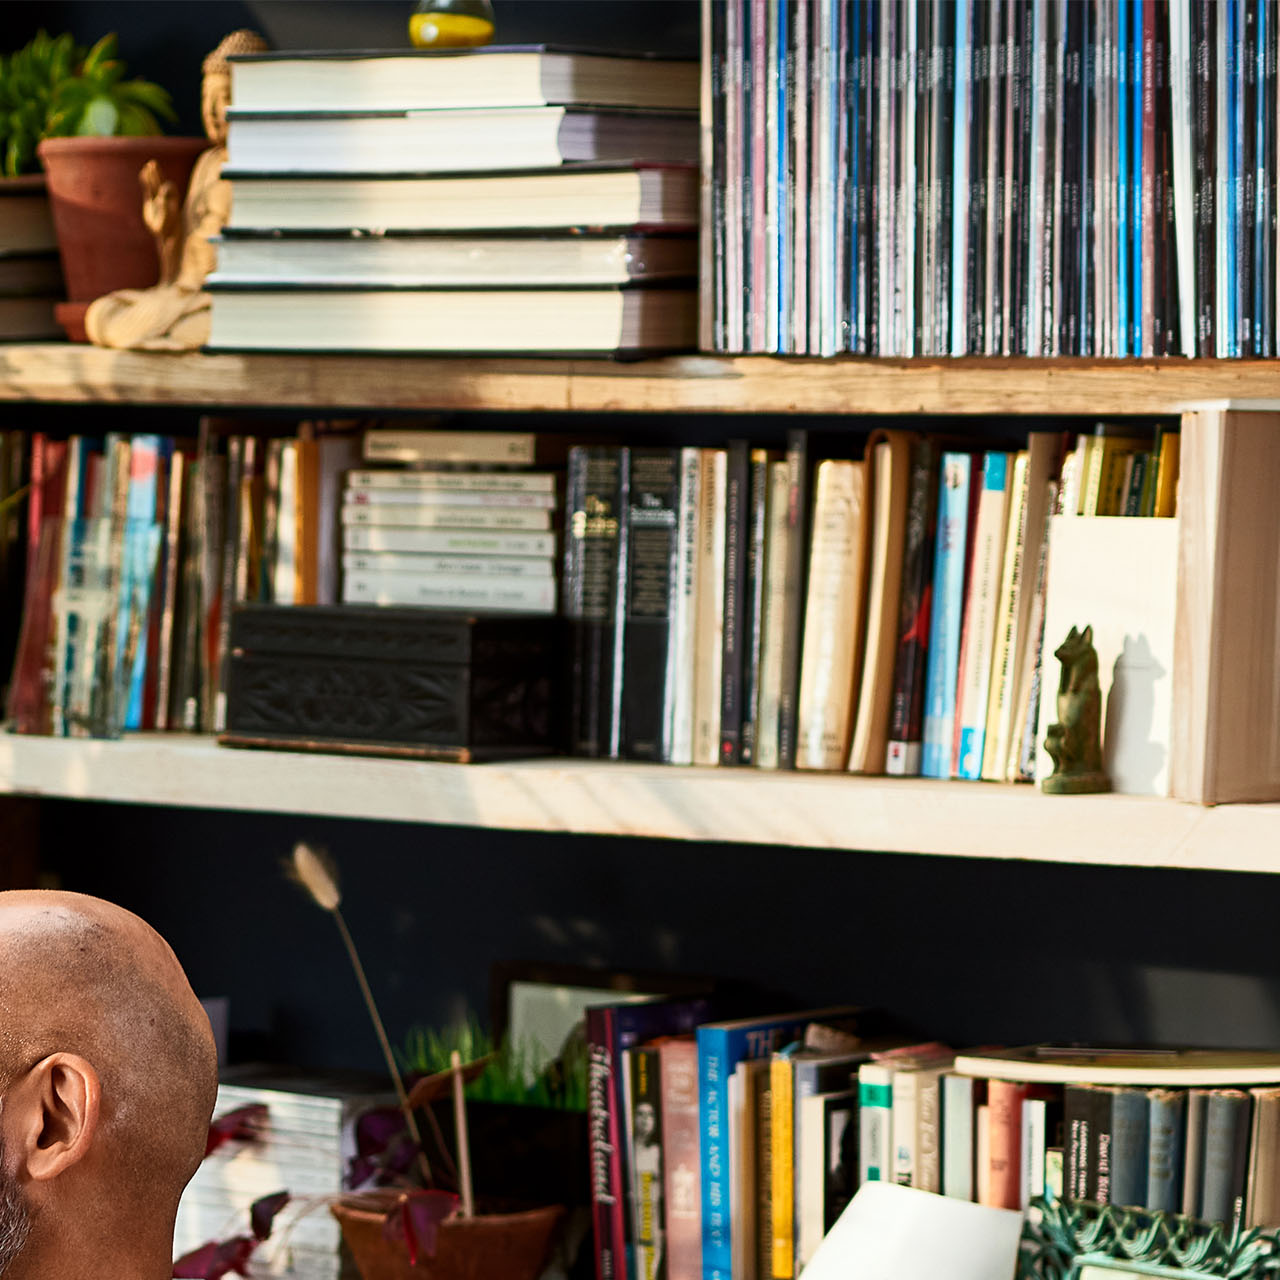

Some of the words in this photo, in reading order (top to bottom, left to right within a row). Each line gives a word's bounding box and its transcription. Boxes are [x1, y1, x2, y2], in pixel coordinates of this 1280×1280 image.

[707, 1056, 718, 1081] THE
[589, 1044, 616, 1205] Theatreland
[707, 1088, 720, 1137] ACTOR
[709, 1143, 720, 1177] AND
